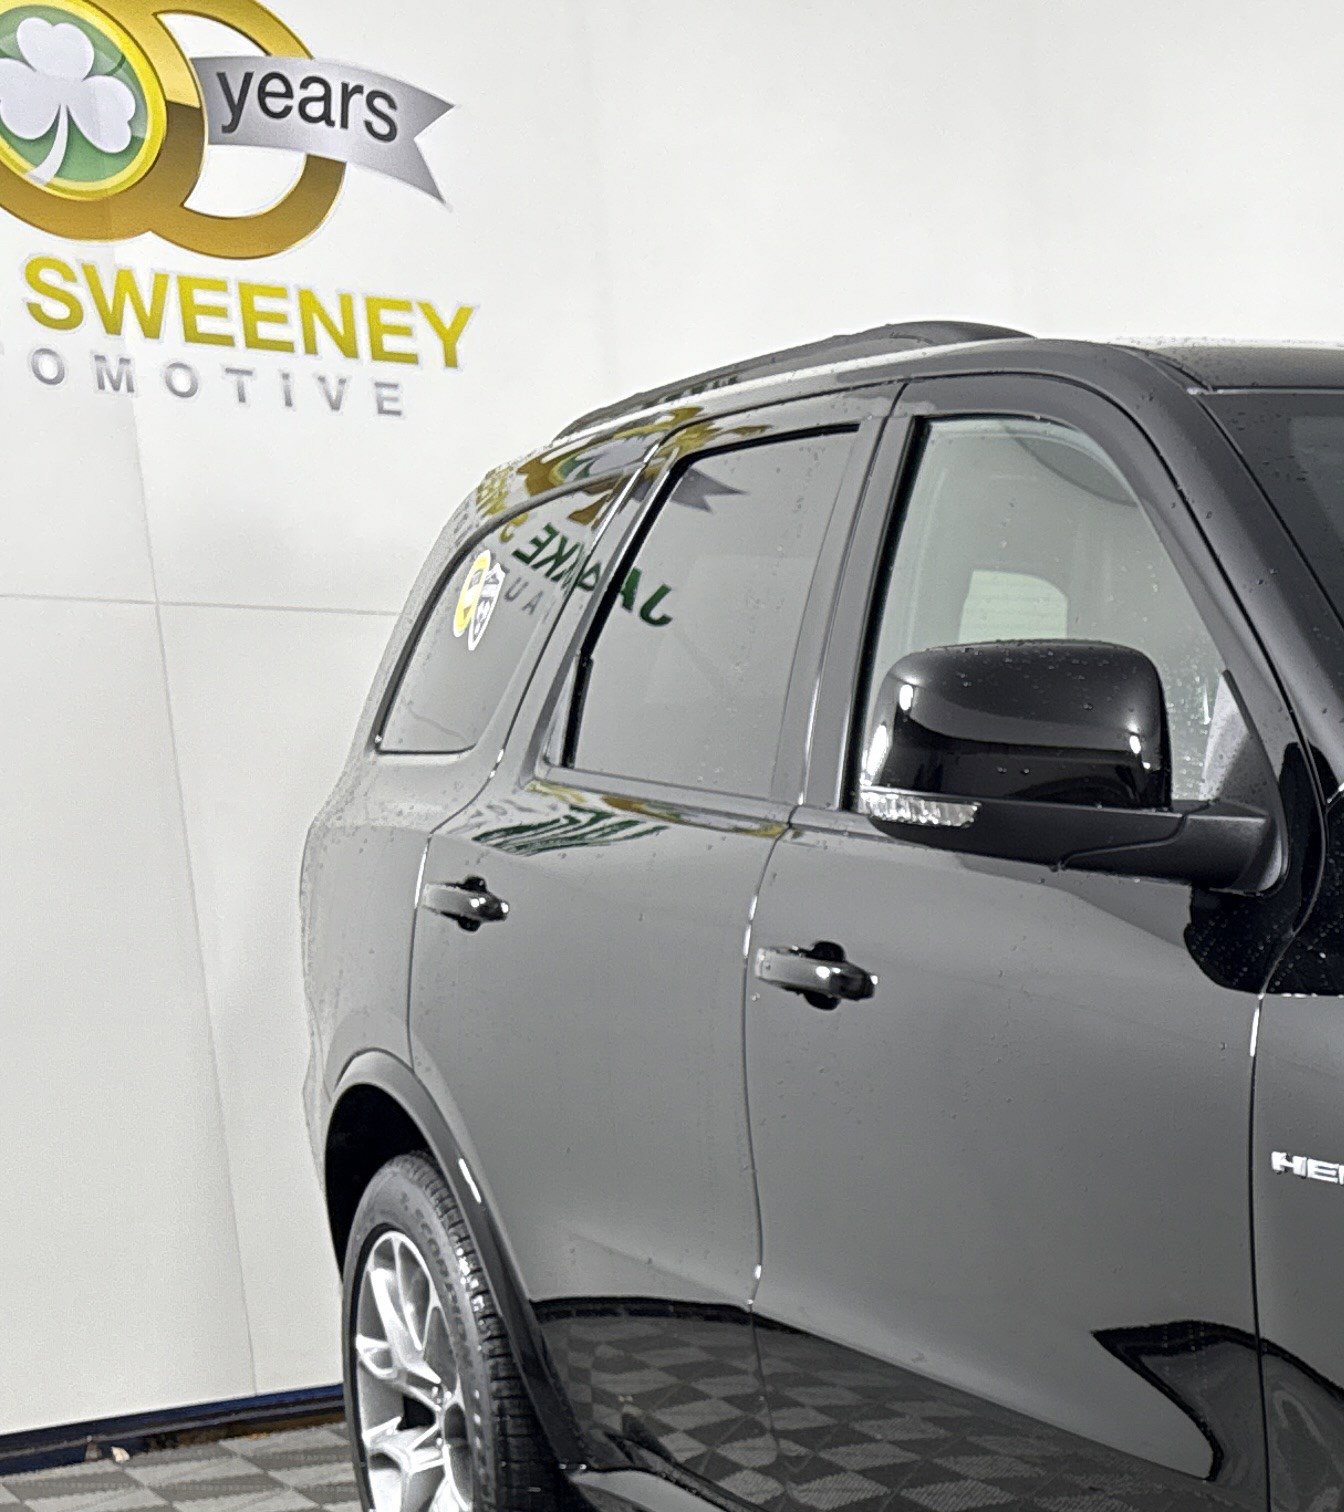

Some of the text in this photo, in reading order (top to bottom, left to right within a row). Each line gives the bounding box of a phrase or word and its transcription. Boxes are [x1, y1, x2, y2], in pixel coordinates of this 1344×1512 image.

[216, 67, 398, 143] years
[23, 256, 475, 369] SWEENEY
[0, 346, 404, 417] OMOTIVE
